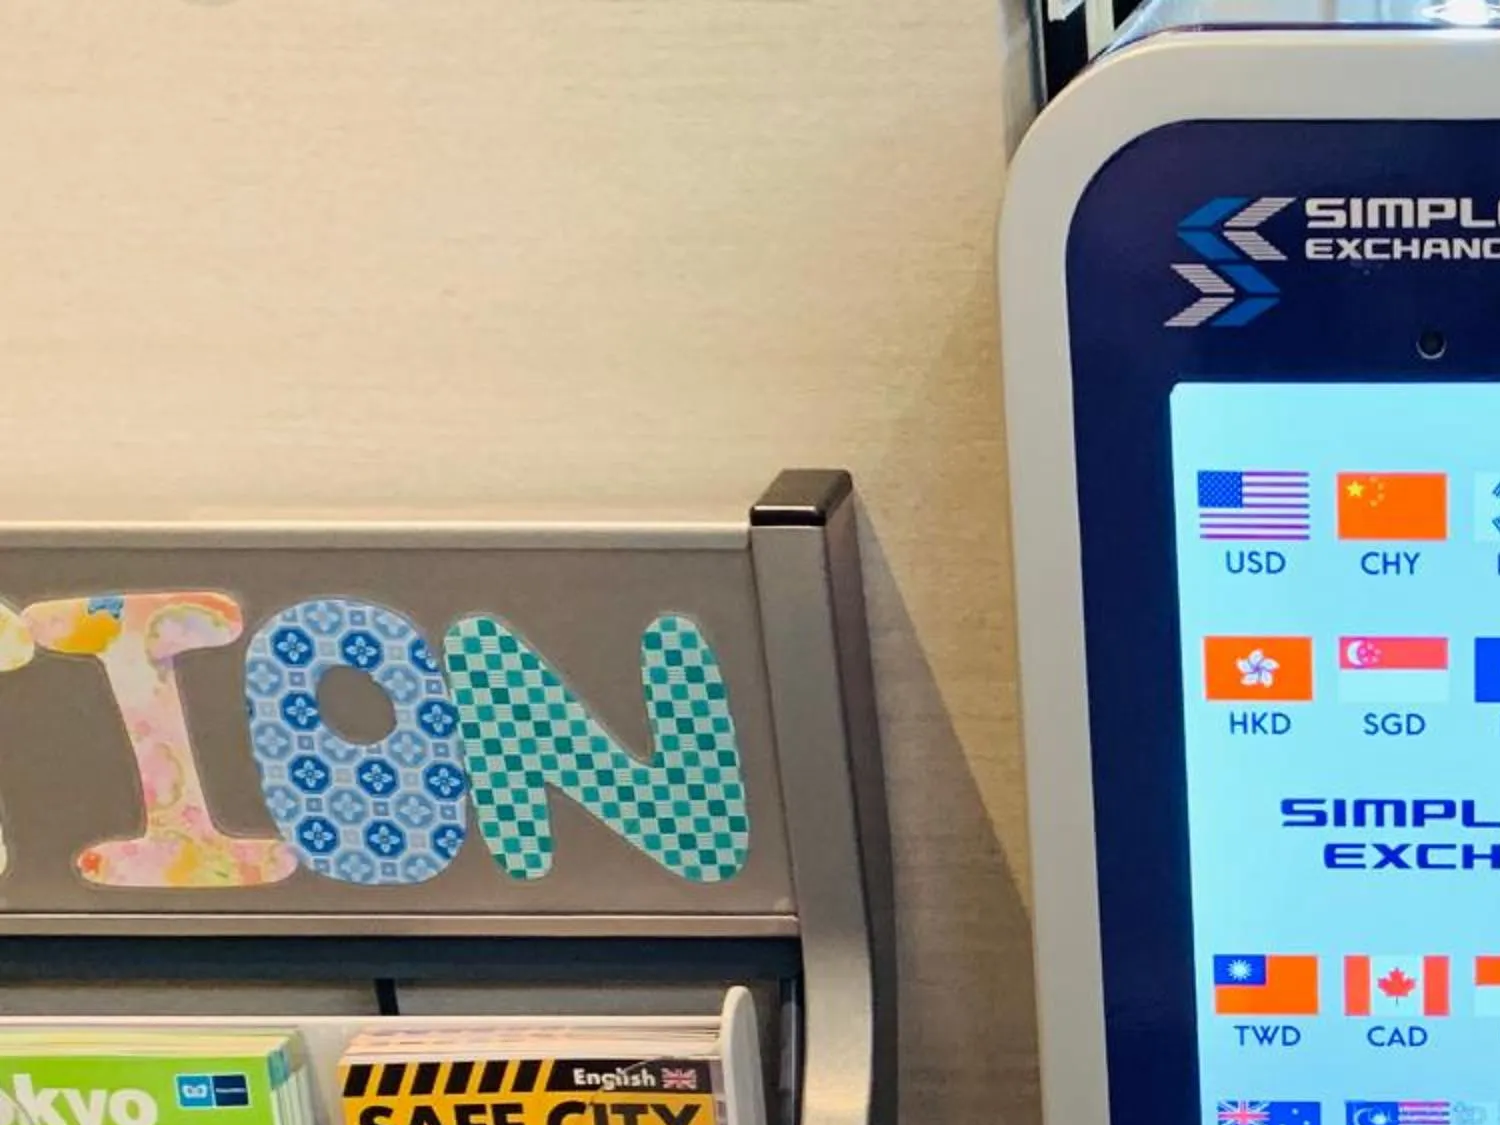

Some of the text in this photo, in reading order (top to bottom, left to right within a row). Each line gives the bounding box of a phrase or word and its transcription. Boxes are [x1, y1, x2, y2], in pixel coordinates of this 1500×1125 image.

[1226, 551, 1286, 575] USD
[1361, 552, 1421, 576] CHY
[1229, 712, 1291, 736] HKD
[1363, 713, 1426, 737] SGD
[0, 590, 748, 886] ION
[1233, 1025, 1301, 1047] TWD
[1366, 1025, 1428, 1048] CAD
[573, 1067, 656, 1090] English
